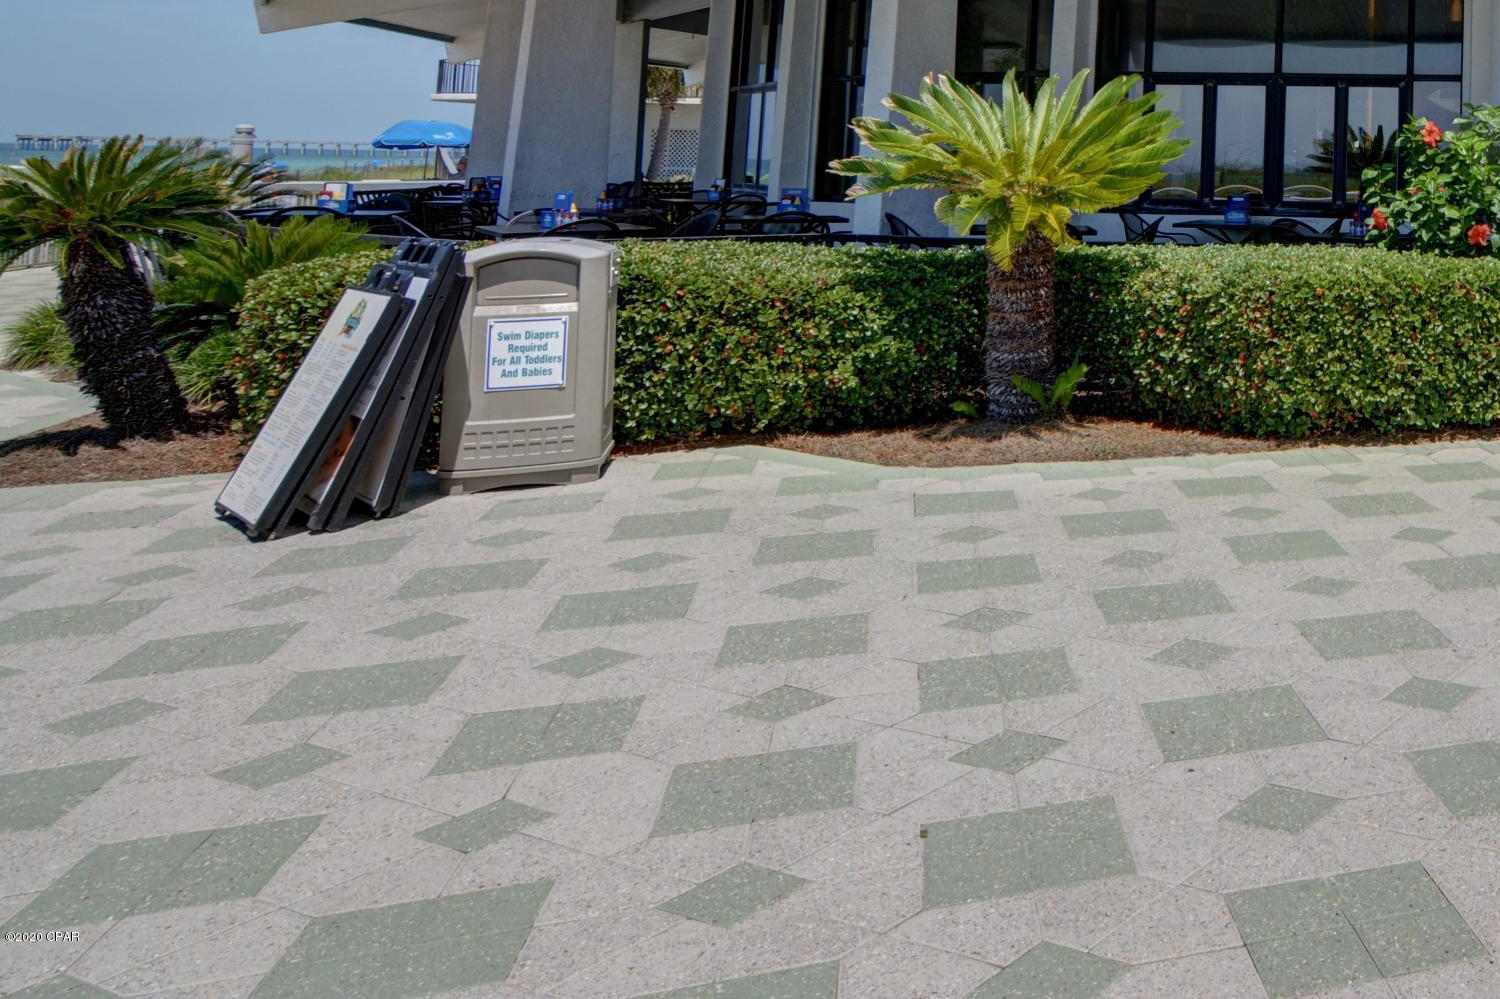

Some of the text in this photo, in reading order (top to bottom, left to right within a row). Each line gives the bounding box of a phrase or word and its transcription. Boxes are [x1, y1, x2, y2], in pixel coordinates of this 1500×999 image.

[497, 330, 560, 342] Swim Diapers
[508, 342, 548, 354] Required
[491, 354, 562, 366] For All Toddlers
[500, 367, 553, 378] And Babies
